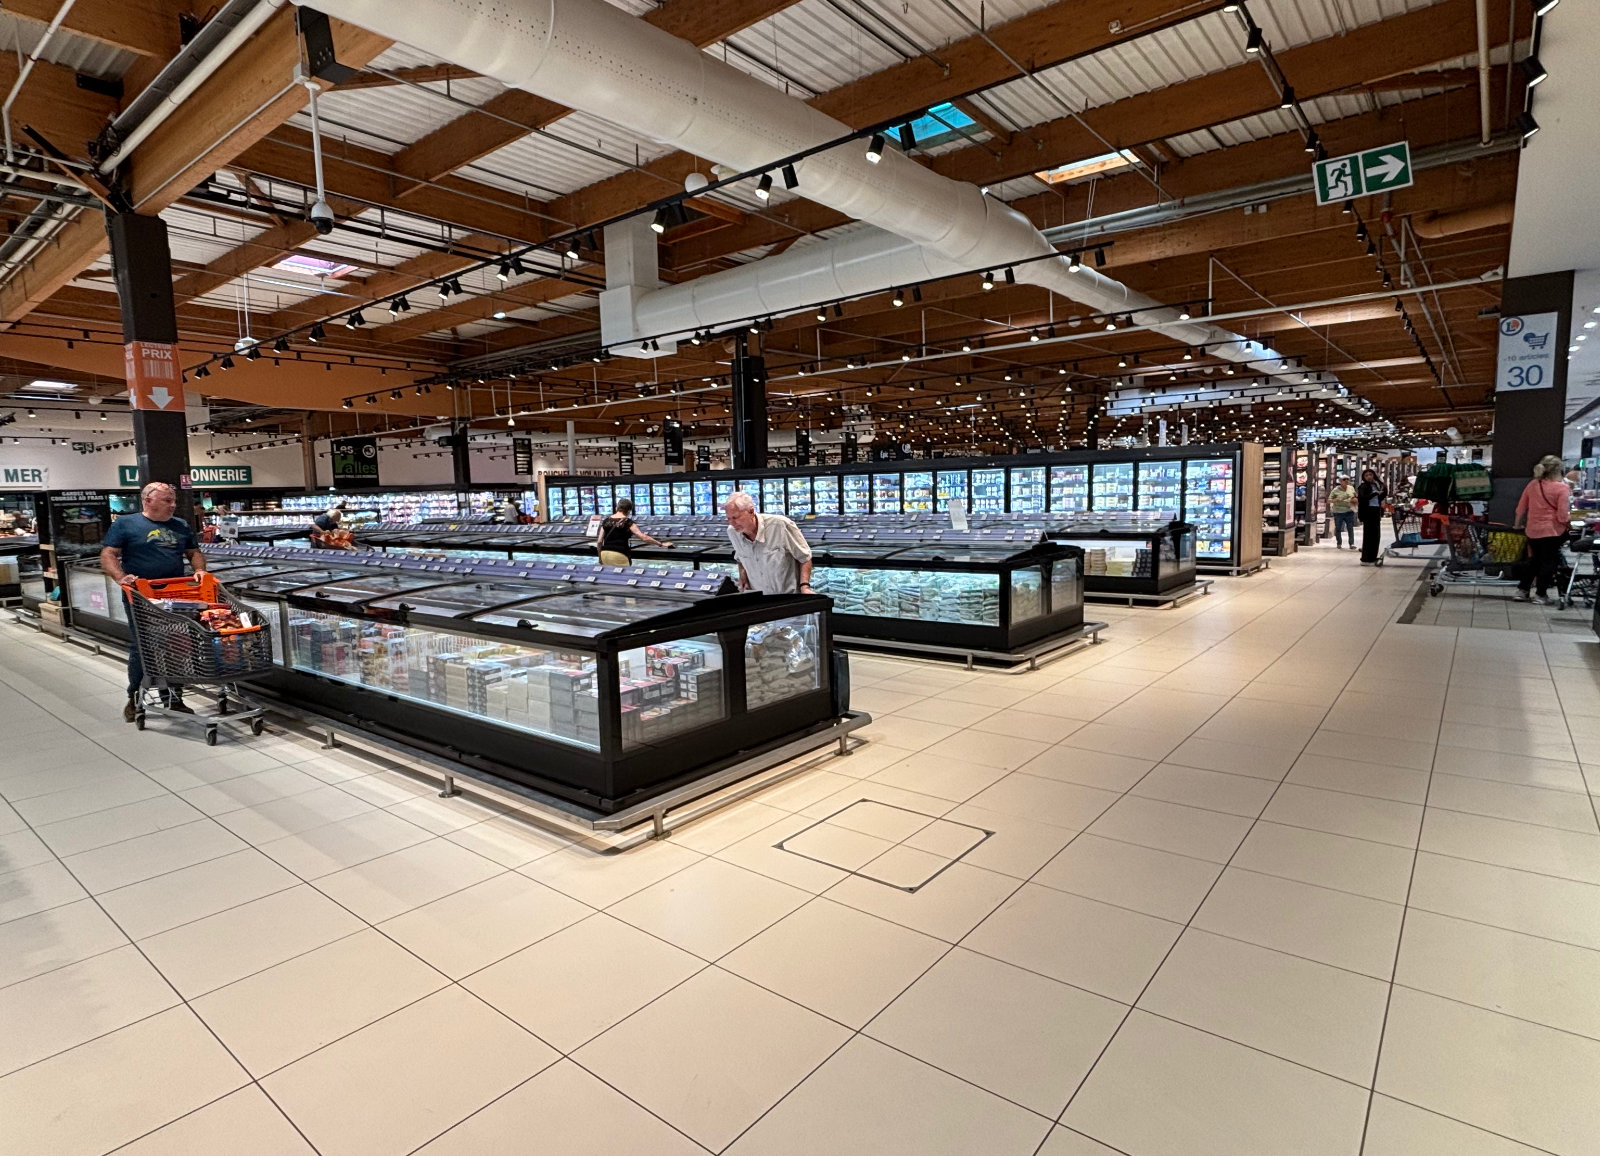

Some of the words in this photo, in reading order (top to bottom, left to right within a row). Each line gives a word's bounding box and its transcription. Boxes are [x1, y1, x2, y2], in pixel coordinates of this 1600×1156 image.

[141, 348, 173, 360] PRIX
[1506, 364, 1544, 388] 30
[333, 443, 354, 454] Les
[4, 468, 43, 483] MER
[190, 468, 248, 482] ONNERIE
